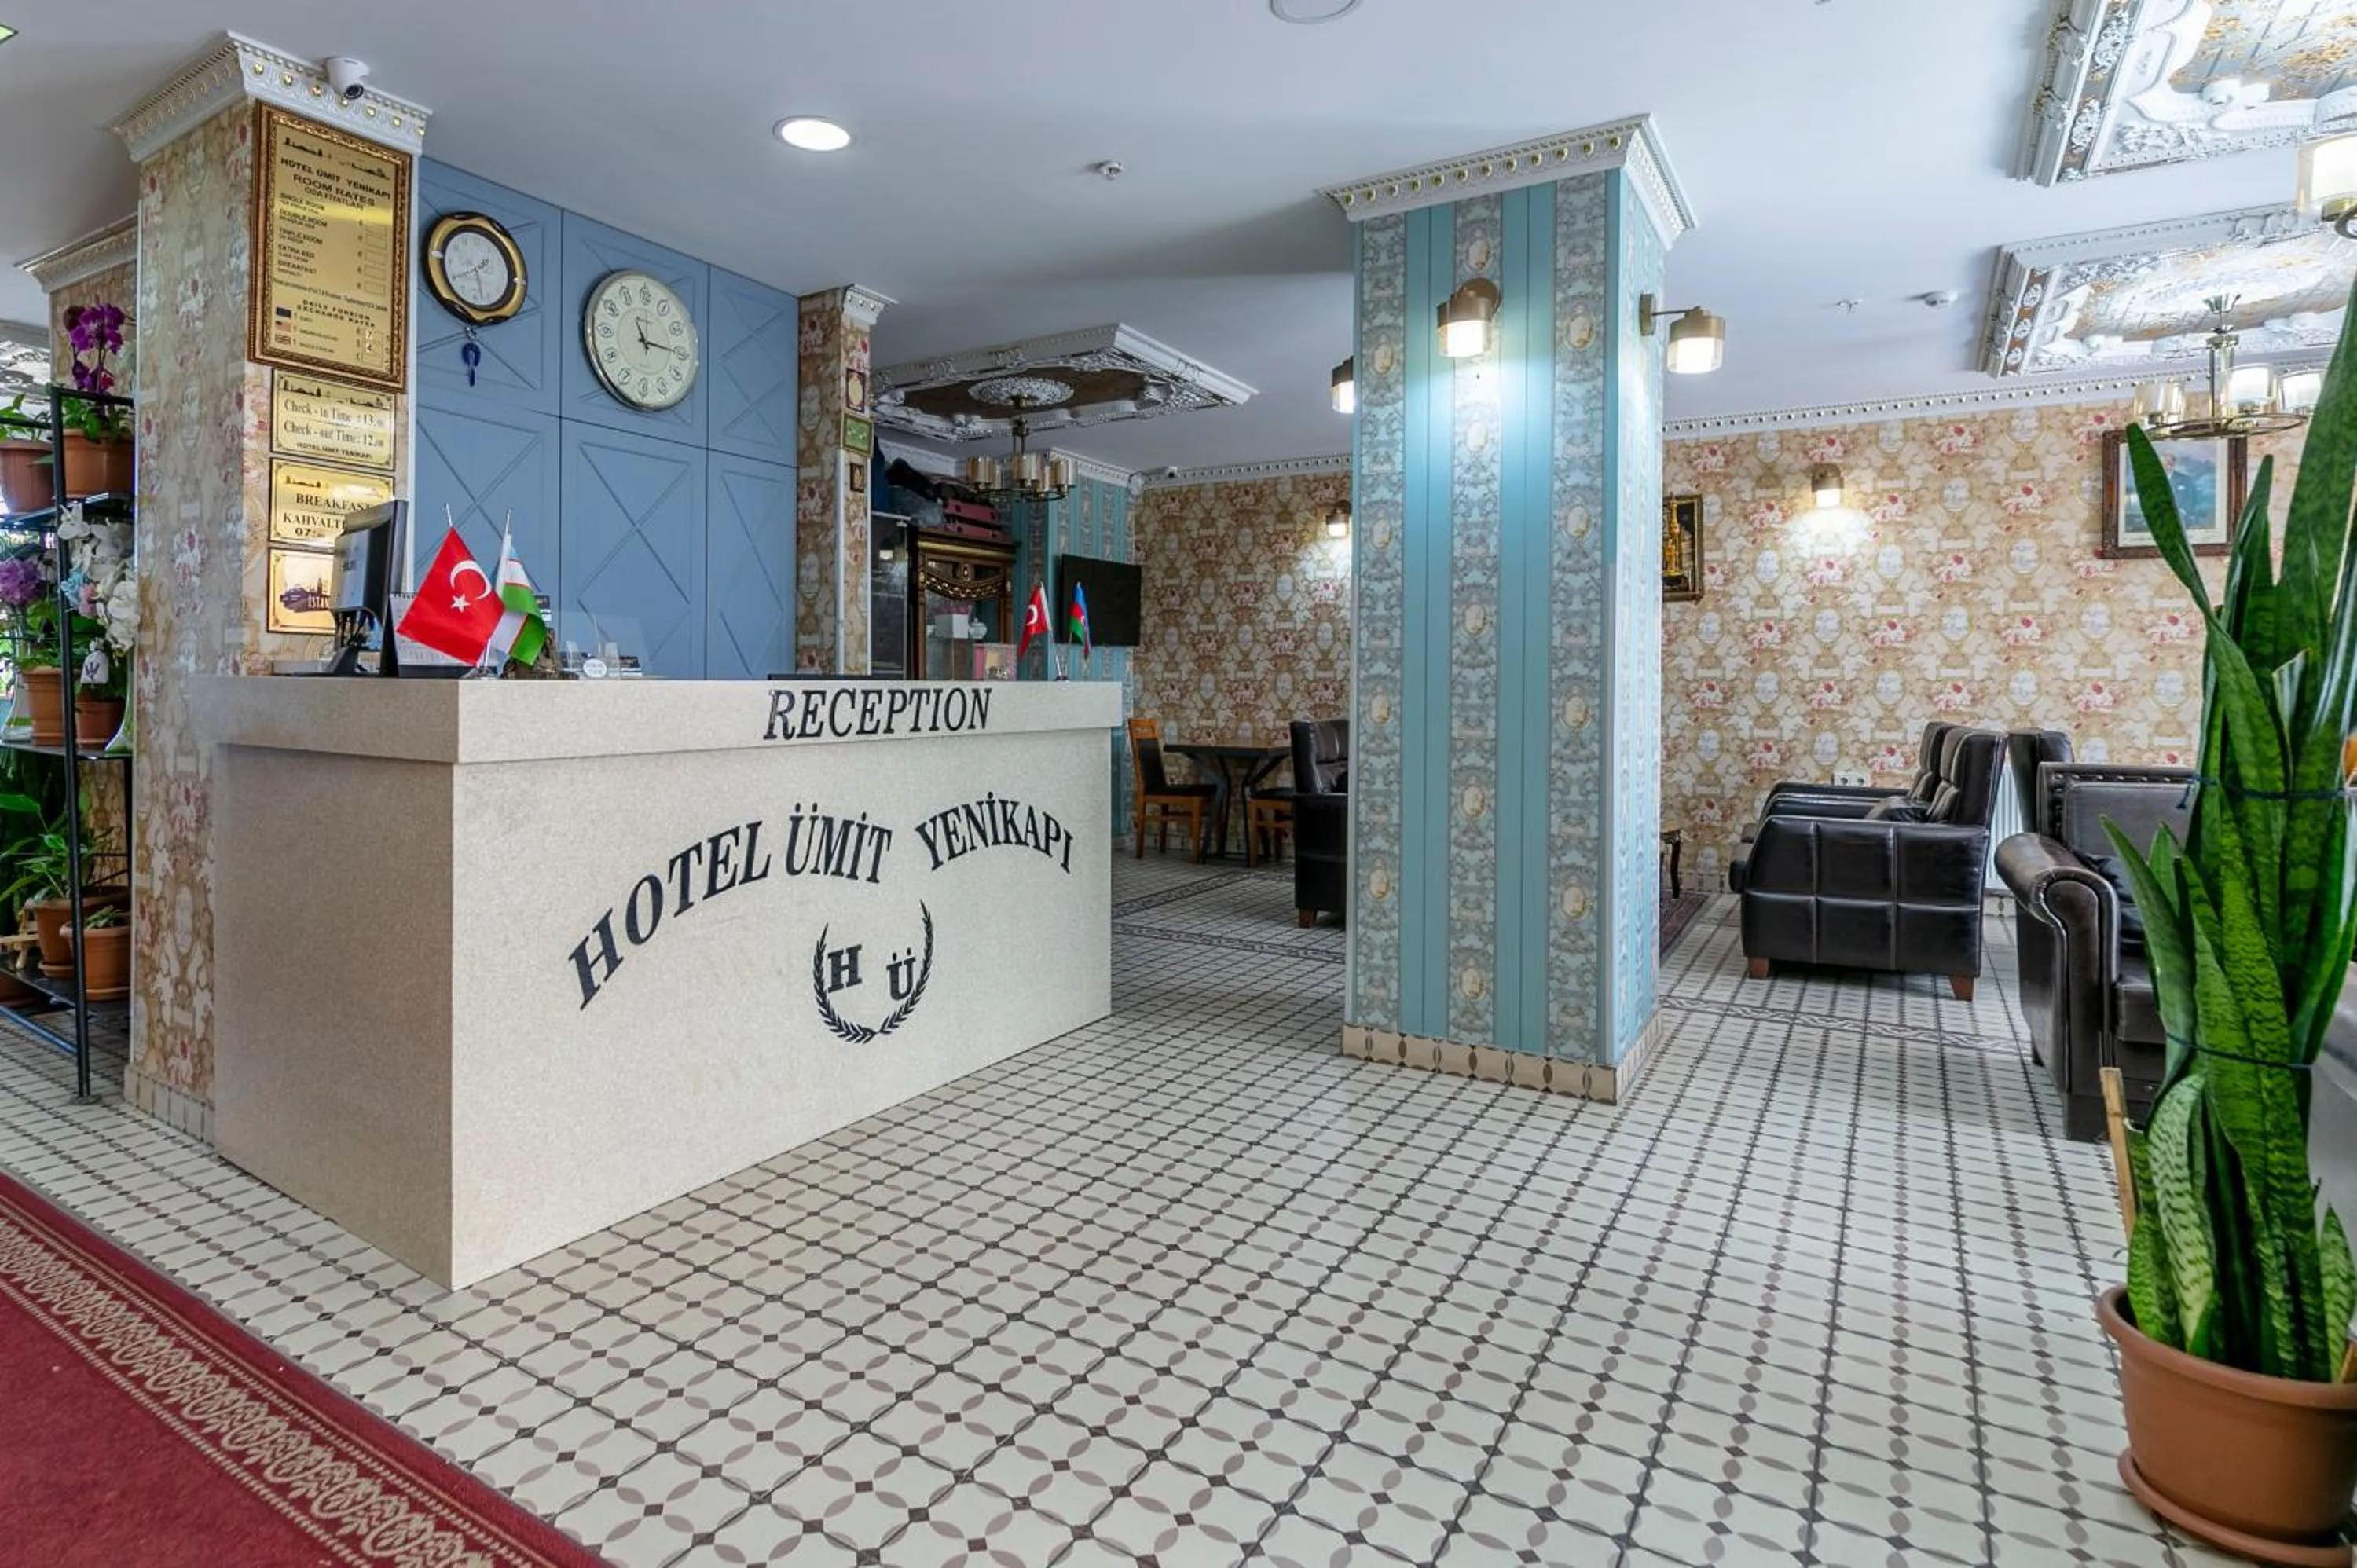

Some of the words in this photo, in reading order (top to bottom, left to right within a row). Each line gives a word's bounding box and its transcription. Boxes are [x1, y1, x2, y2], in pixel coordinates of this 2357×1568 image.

[280, 157, 314, 174] HOTEL
[293, 173, 332, 192] ROOM
[335, 187, 376, 206] RATES
[284, 398, 312, 416] Check
[320, 406, 328, 418] in
[332, 407, 351, 423] Time
[284, 420, 312, 438] Check
[296, 442, 321, 452] HOTEL
[296, 493, 371, 512] BREAKFAST
[284, 511, 346, 529] KAHVALTI
[763, 687, 992, 740] RECEPTION
[567, 820, 772, 1011] HOTEL
[785, 802, 893, 884] ÜMİT
[915, 790, 1075, 874] YENİKAPI
[827, 943, 863, 994] H
[885, 947, 917, 1001] Ü
